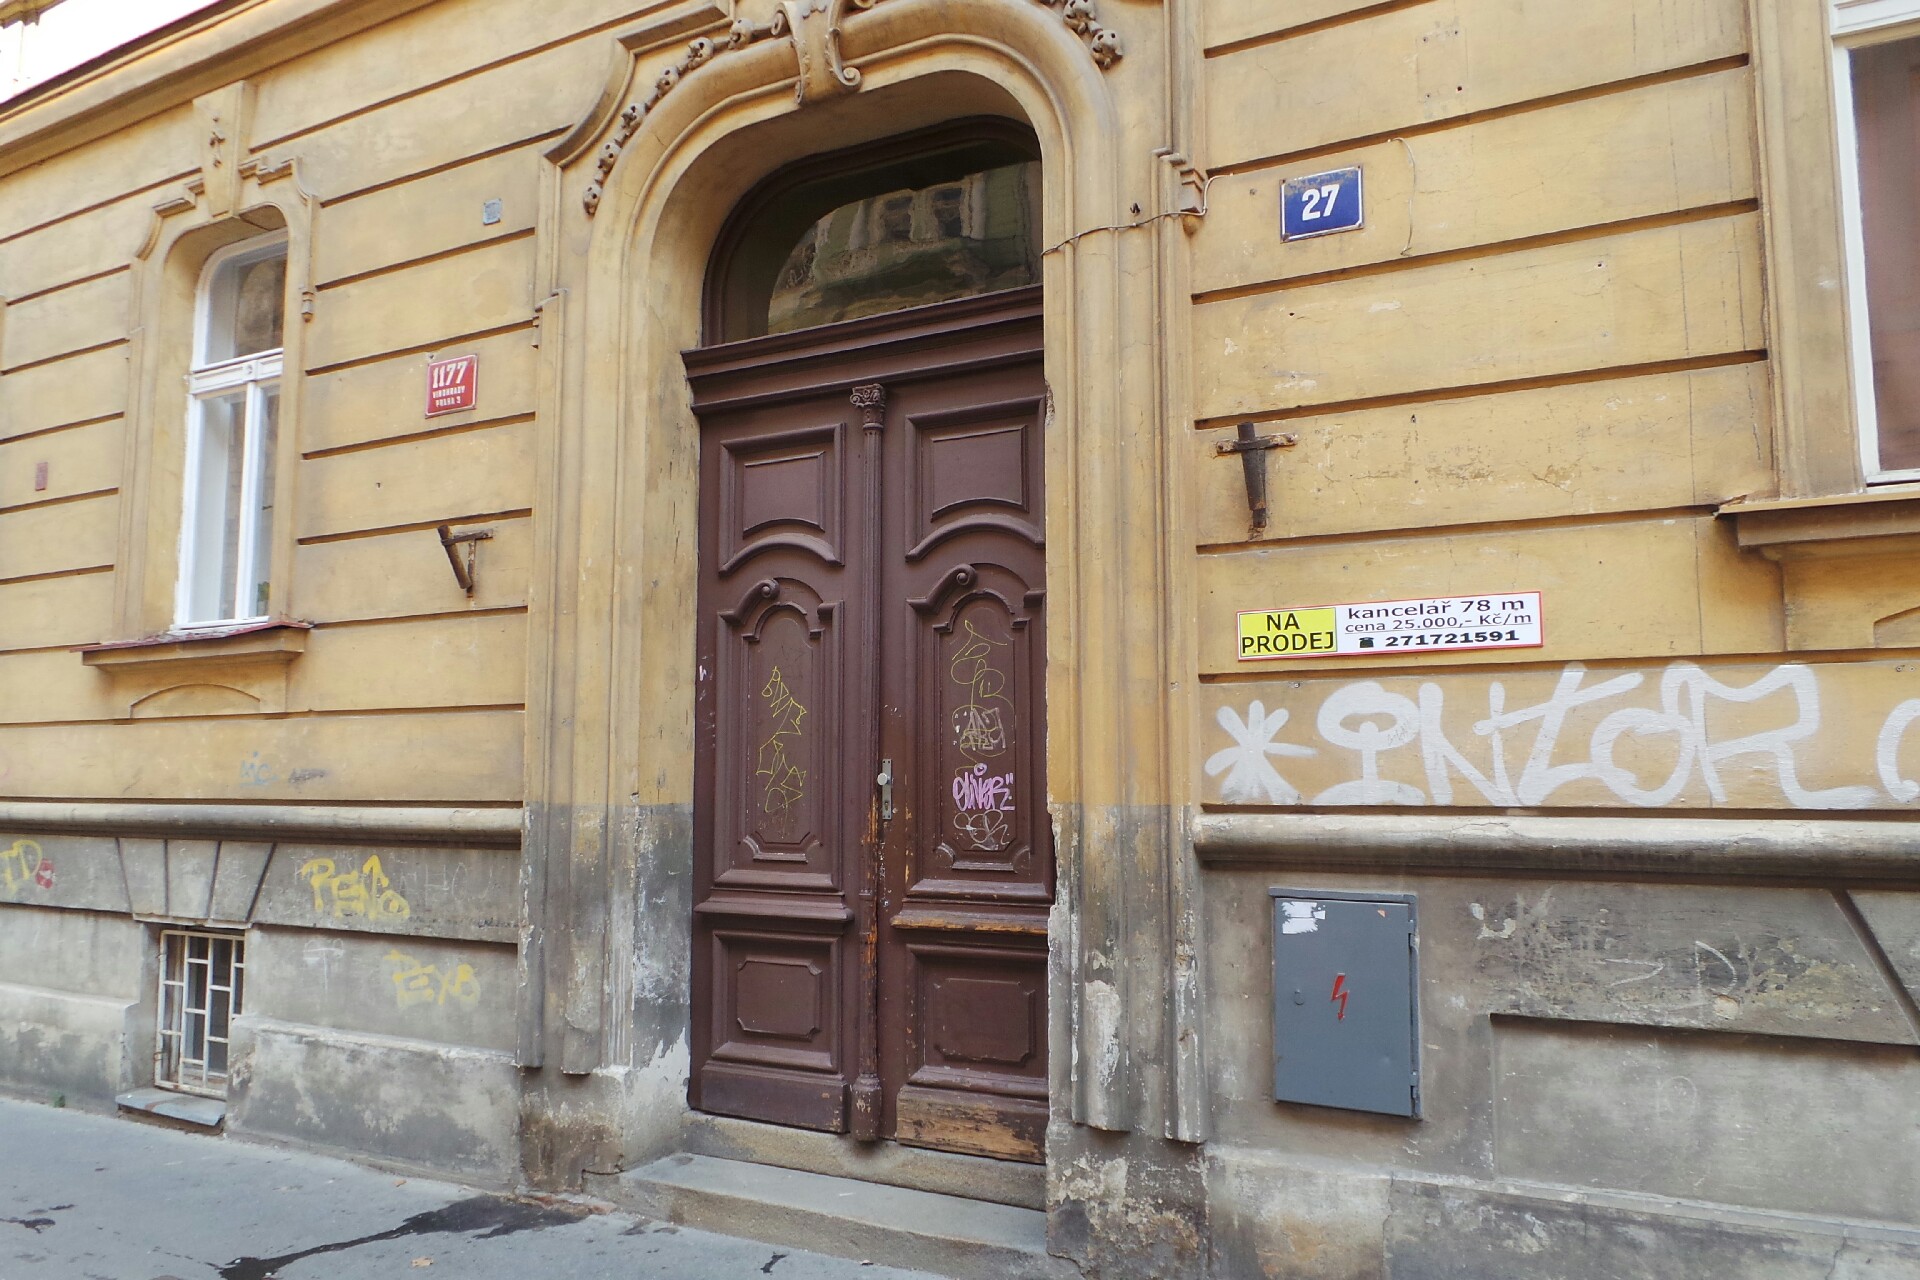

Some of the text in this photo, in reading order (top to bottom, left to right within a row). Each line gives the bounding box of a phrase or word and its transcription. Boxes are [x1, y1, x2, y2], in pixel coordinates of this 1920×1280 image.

[1302, 184, 1340, 221] 27
[432, 361, 468, 389] 1177
[1348, 600, 1451, 620] kancelář
[1460, 599, 1491, 613] 78
[1266, 612, 1300, 632] NA
[1345, 611, 1532, 633] cena 25.000,- Kč/m
[1241, 631, 1334, 654] PRODEJ
[1385, 629, 1520, 648] 271721591
